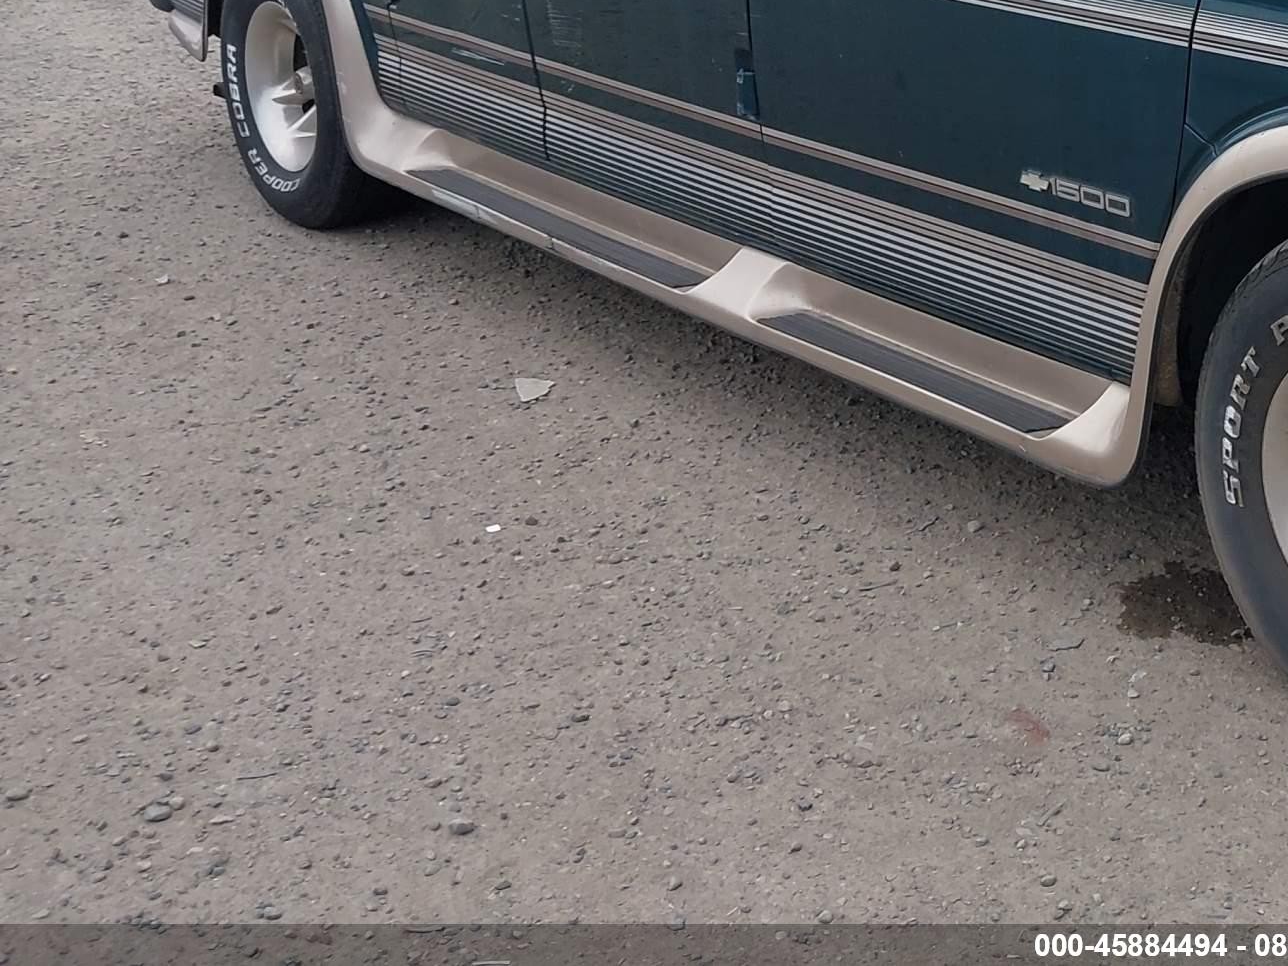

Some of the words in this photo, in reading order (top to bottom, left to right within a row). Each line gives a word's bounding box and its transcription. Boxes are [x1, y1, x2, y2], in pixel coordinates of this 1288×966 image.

[226, 44, 250, 138] COBRA
[248, 147, 301, 192] COOPER
[1049, 177, 1131, 218] 1500
[1222, 346, 1262, 508] SPORT
